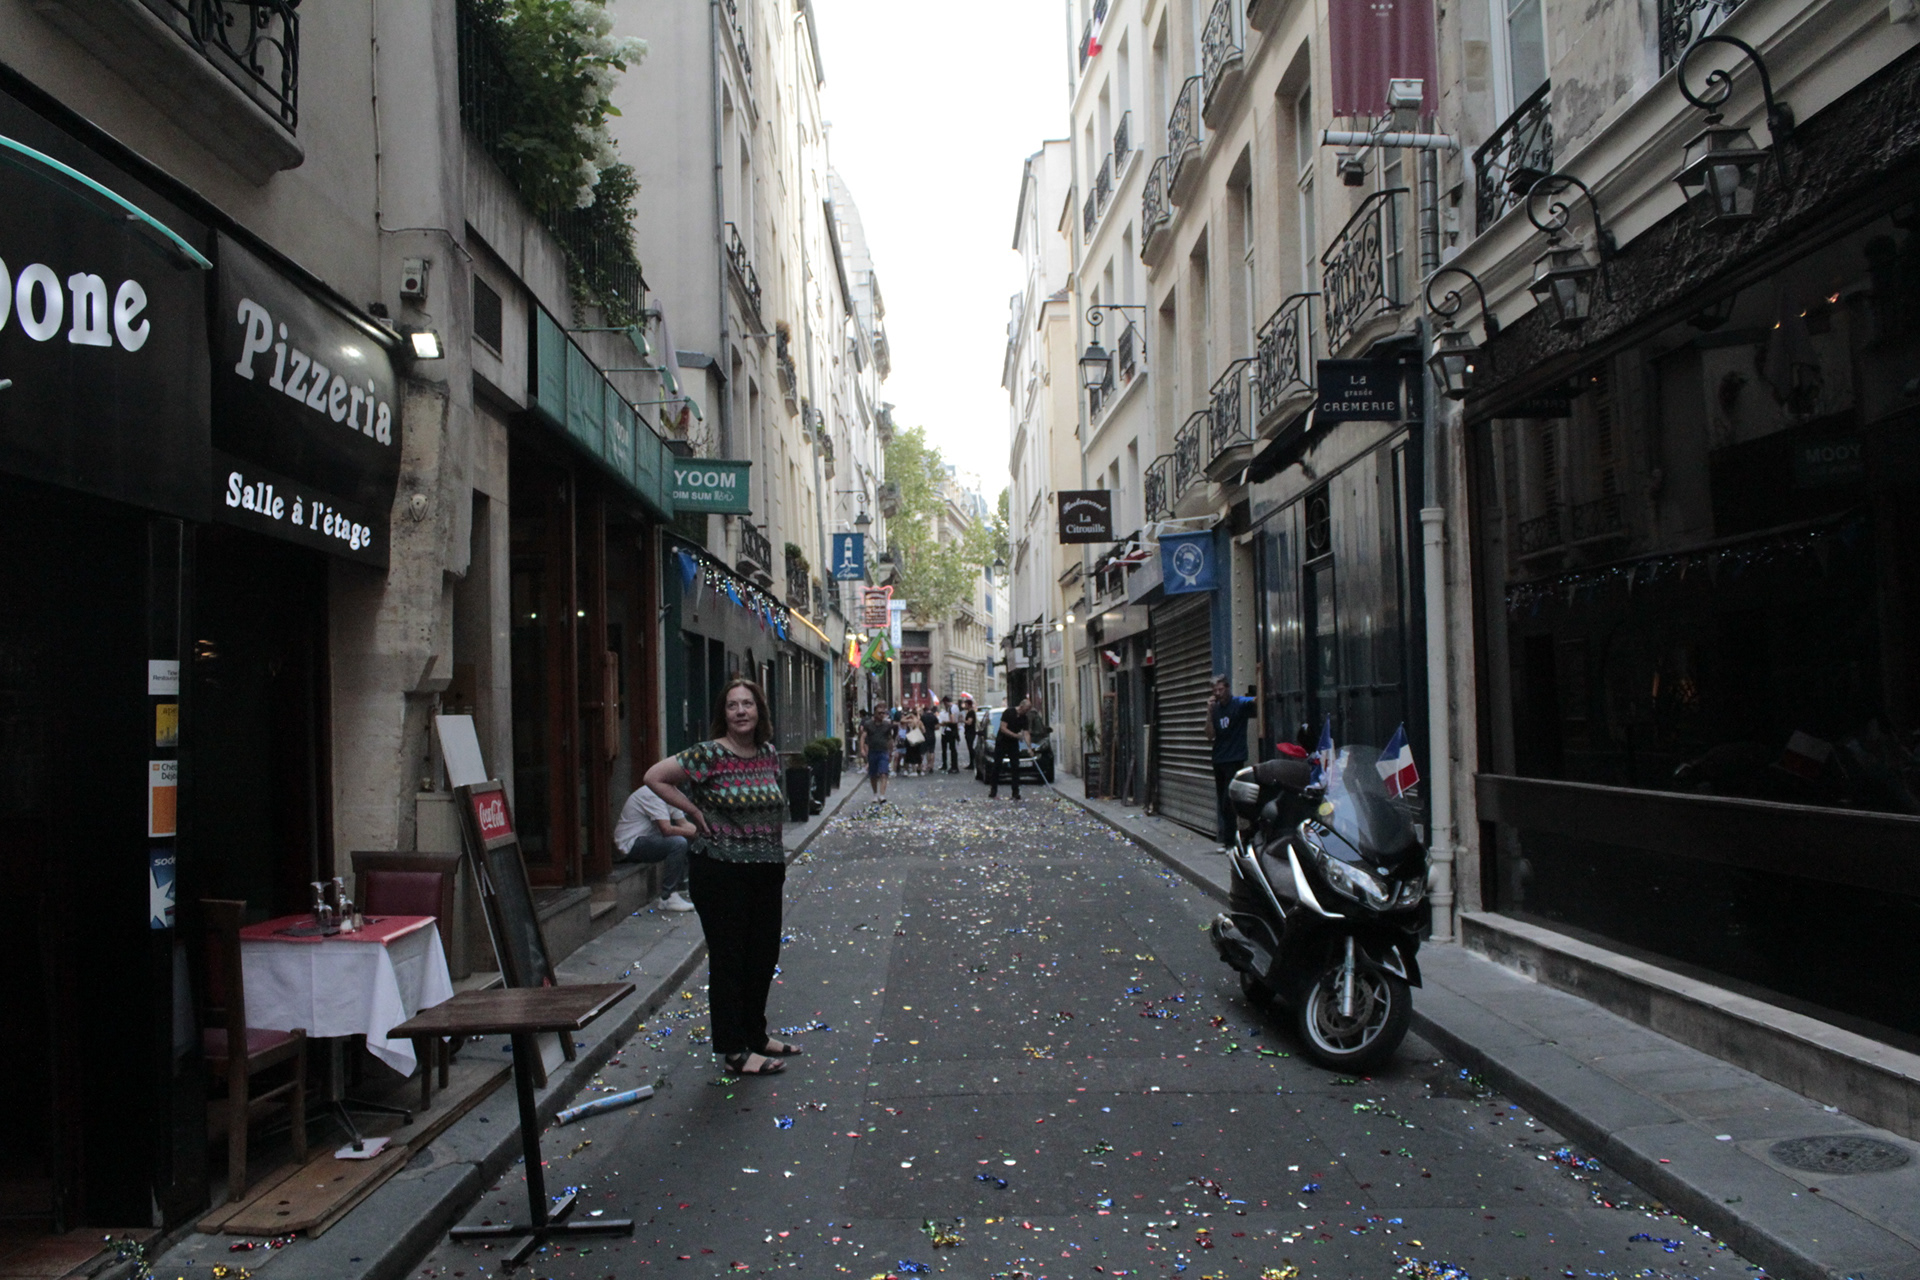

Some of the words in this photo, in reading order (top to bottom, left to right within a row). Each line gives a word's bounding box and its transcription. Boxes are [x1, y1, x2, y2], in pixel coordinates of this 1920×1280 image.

[235, 298, 393, 446] Pizzeria
[1350, 375, 1367, 385] La
[1344, 389, 1373, 398] grande
[1323, 402, 1395, 412] CREMERIE
[673, 470, 736, 488] YOOM
[672, 491, 690, 500] DIM
[691, 491, 713, 500] SUM
[225, 471, 285, 522] Salle
[291, 496, 304, 527] à
[310, 502, 372, 551] l'étage
[1079, 513, 1092, 523] La
[1065, 523, 1106, 534] Citrouille
